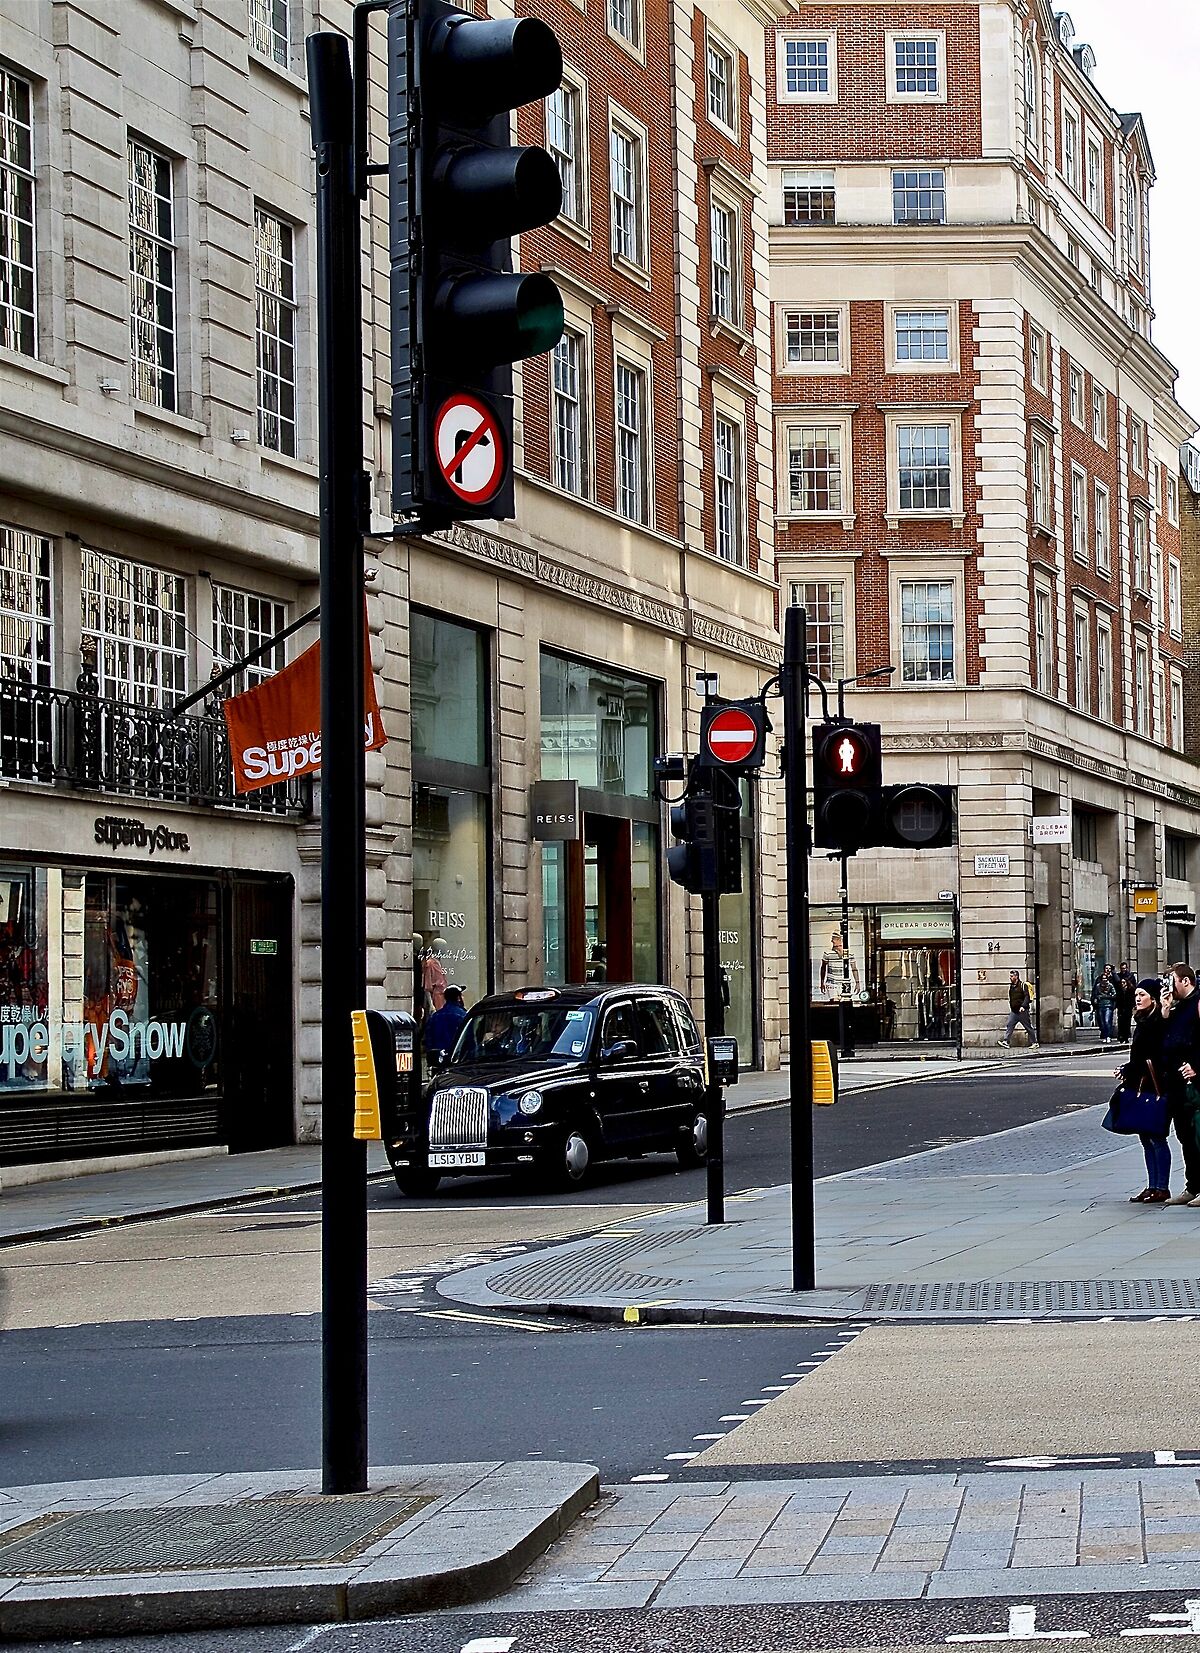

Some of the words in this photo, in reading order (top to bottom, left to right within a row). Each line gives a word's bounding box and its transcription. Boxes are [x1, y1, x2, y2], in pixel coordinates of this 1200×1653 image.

[242, 711, 374, 780] Supey
[536, 814, 575, 824] REISS
[429, 910, 466, 928] REISS
[987, 941, 1001, 952] 24
[434, 1154, 456, 1165] LS13
[458, 1153, 479, 1164] YBU
